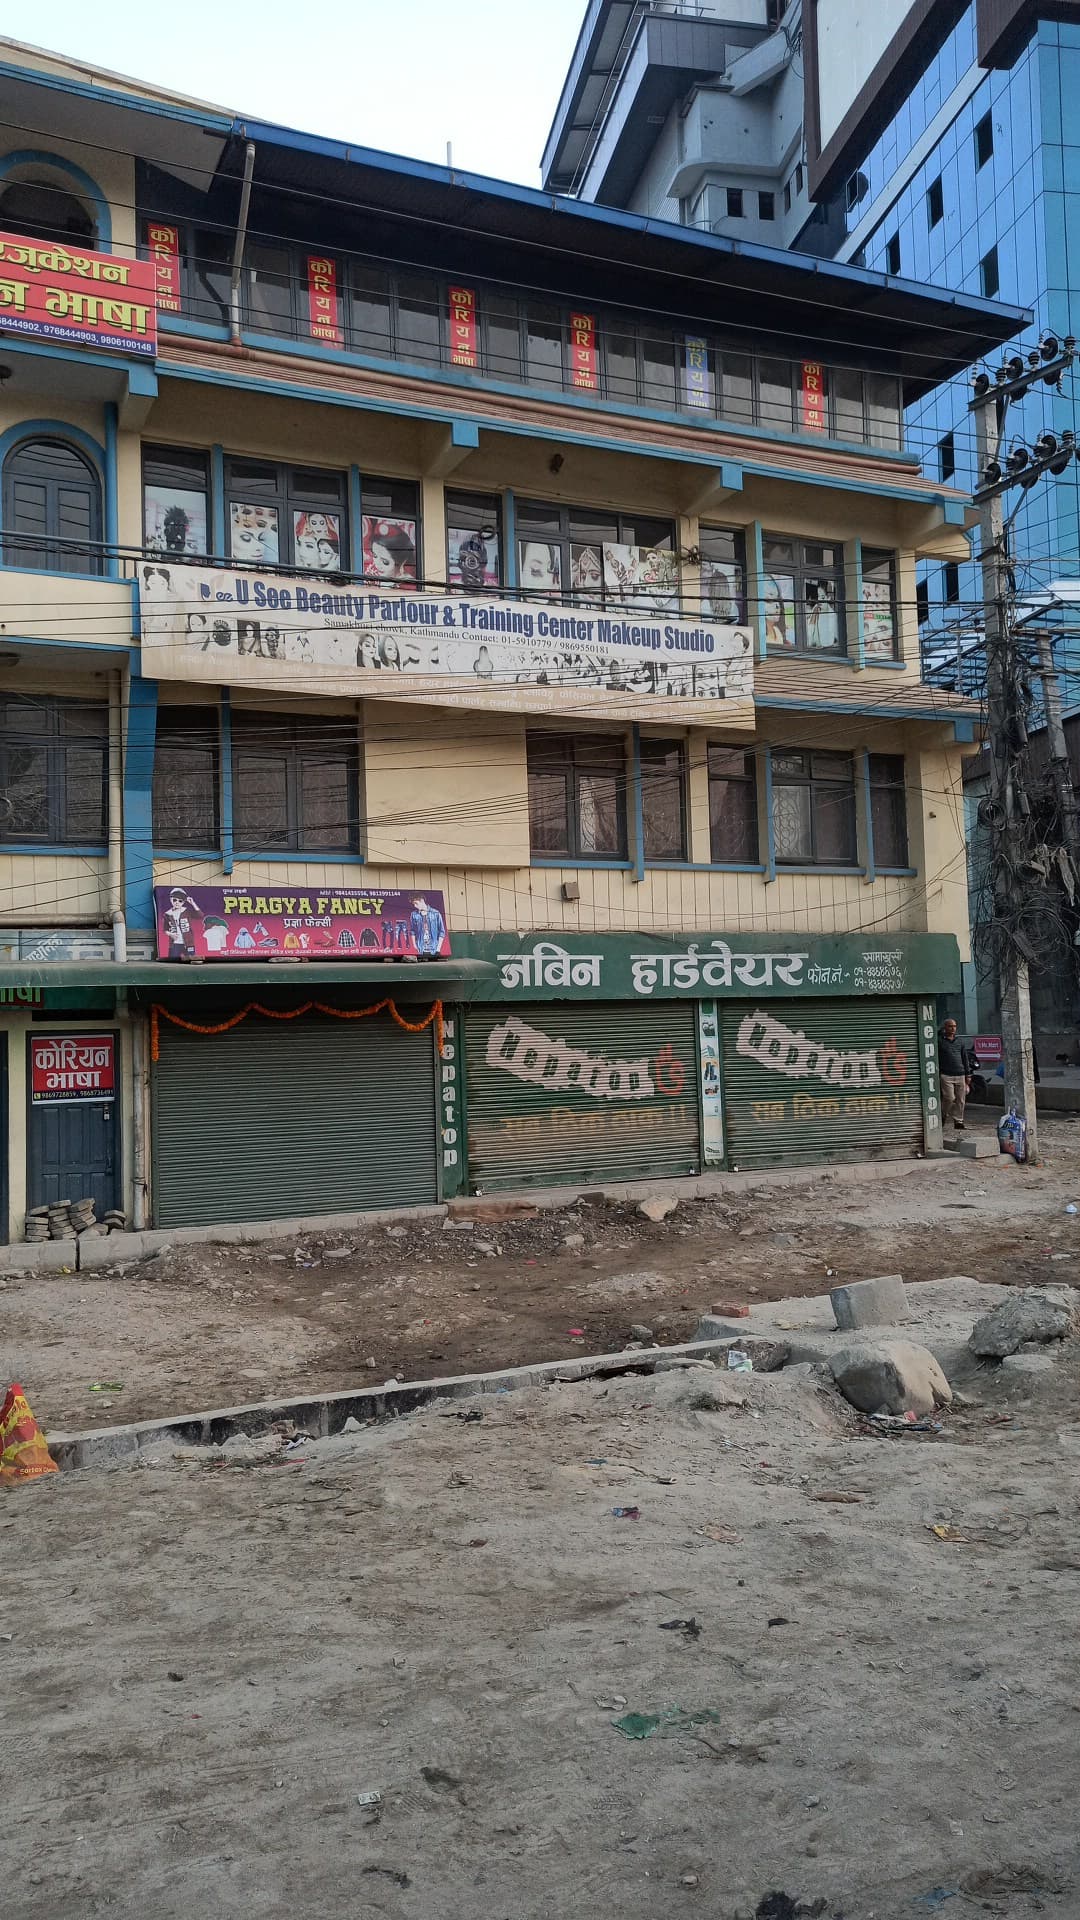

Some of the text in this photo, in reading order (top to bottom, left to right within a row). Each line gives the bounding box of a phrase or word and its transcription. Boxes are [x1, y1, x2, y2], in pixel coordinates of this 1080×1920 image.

[45, 286, 151, 335] भाषा
[100, 335, 152, 351] 9806100148
[254, 580, 292, 608] See
[296, 586, 364, 621] Beauty
[368, 594, 439, 627] Parlour
[443, 604, 456, 627] &
[459, 603, 534, 638] Training
[537, 611, 594, 641] Center
[598, 618, 661, 650] Makeup
[664, 625, 715, 653] Studio
[410, 626, 460, 640] Kathmandu
[461, 631, 499, 643] Contact:
[223, 896, 385, 915] PRAGYA FANCY
[497, 940, 809, 994] नबिन हार्डवेयर
[35, 1039, 110, 1070] कोरियन
[922, 1004, 939, 1130] Nepatop
[46, 1071, 102, 1088] भाषा
